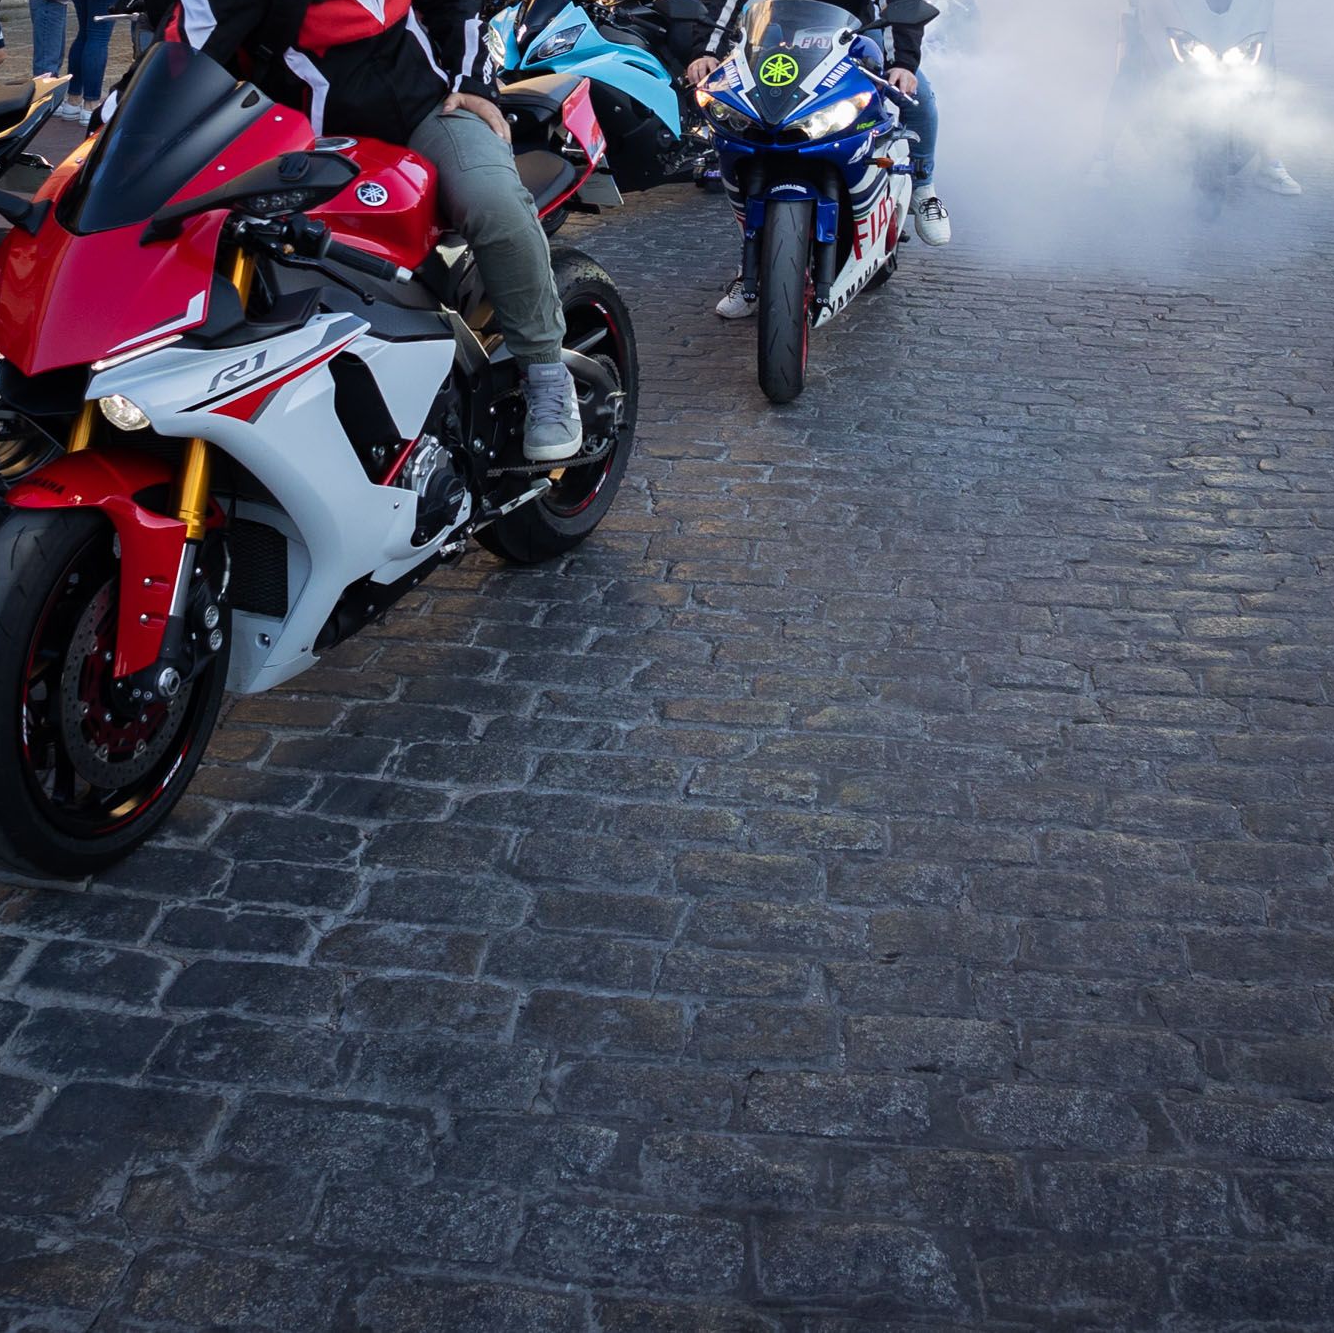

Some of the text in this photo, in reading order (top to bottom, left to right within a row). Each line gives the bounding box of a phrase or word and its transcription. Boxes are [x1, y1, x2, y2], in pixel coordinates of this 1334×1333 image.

[821, 62, 854, 89] YAMAHA
[826, 258, 878, 316] YAMAHA
[207, 350, 267, 393] R1
